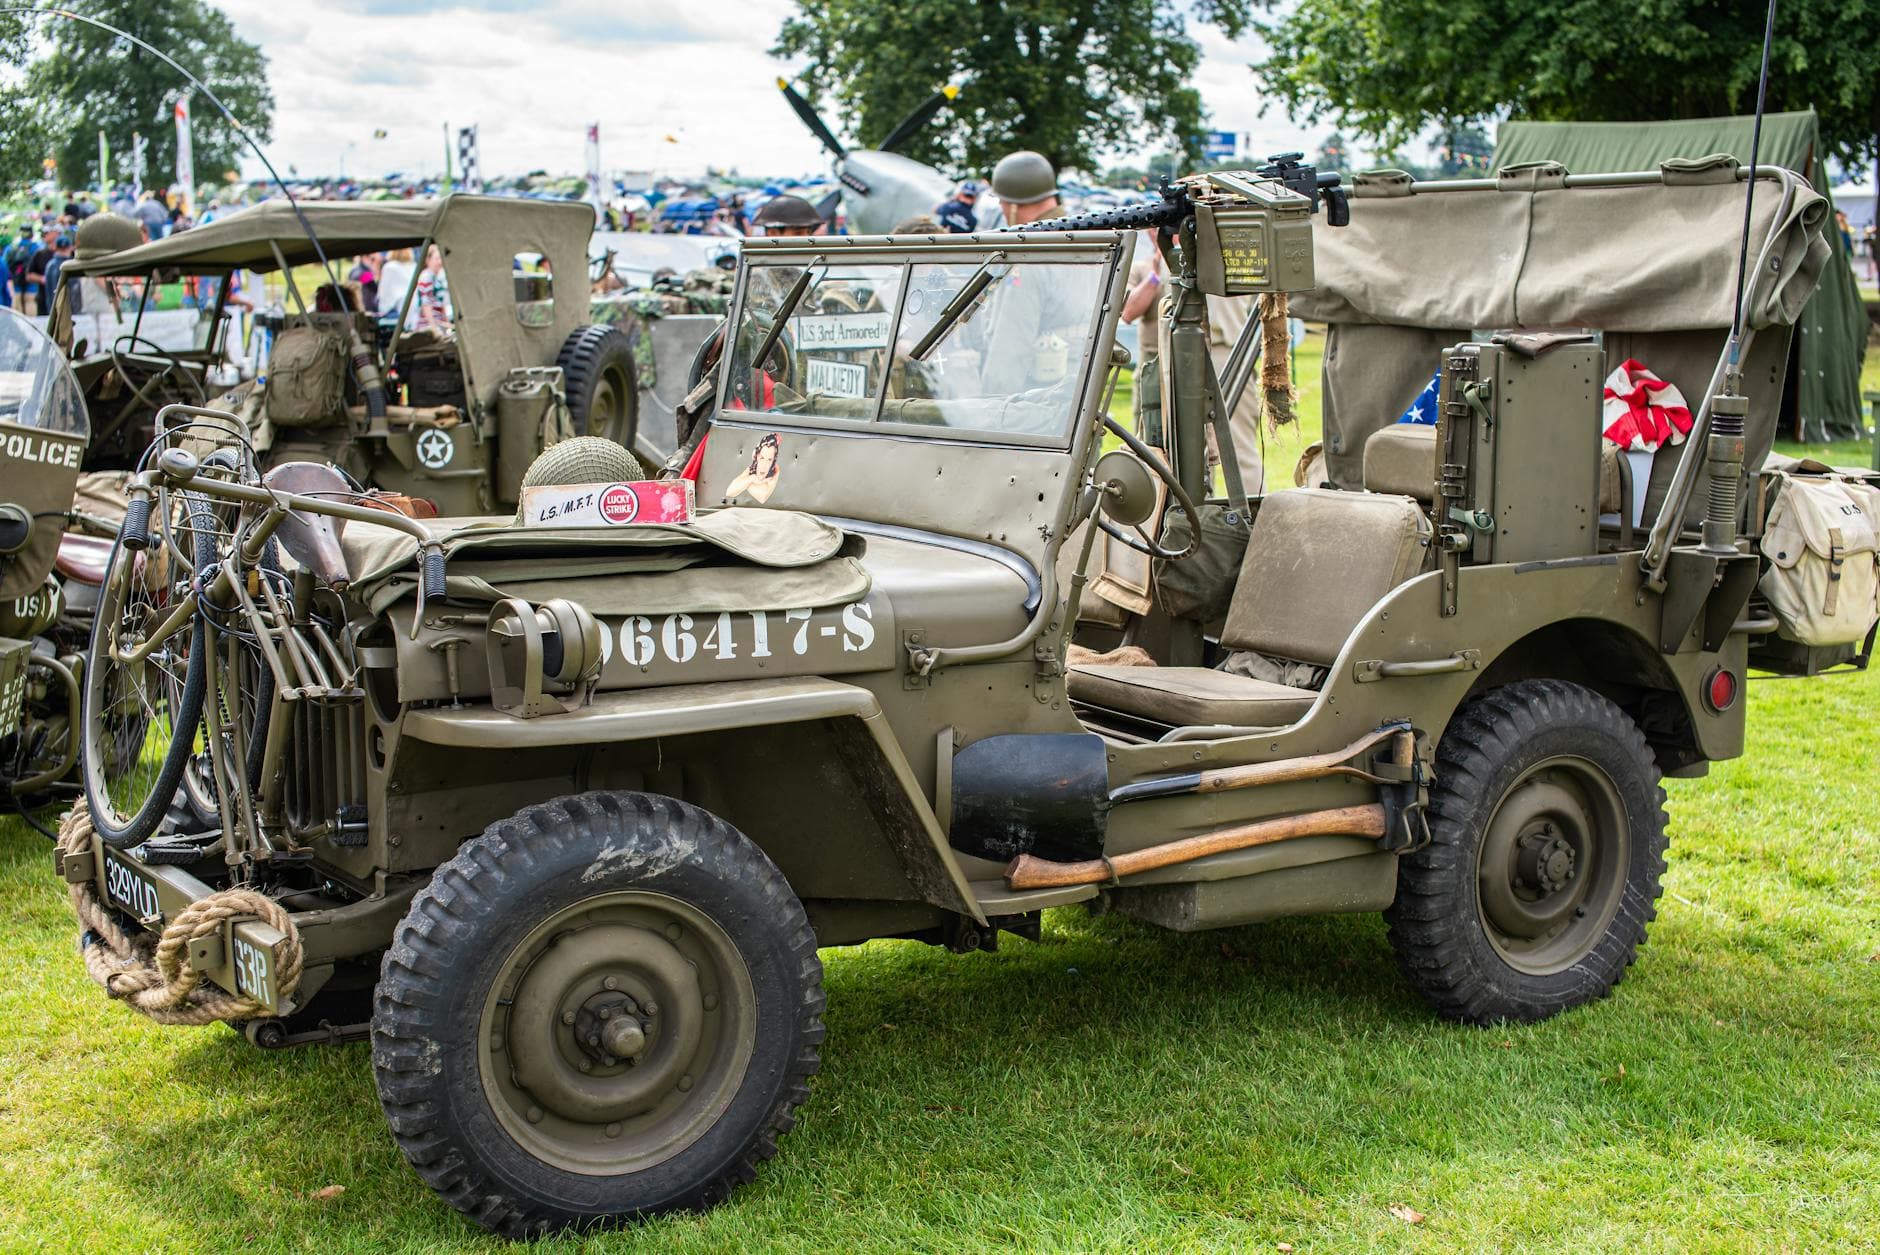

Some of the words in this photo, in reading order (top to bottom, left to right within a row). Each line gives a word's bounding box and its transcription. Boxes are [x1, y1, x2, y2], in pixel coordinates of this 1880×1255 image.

[801, 325, 815, 342] US
[818, 322, 835, 342] 3rd
[838, 321, 880, 339] Armored
[606, 494, 631, 505] LUCKY
[605, 504, 632, 514] STRIKE
